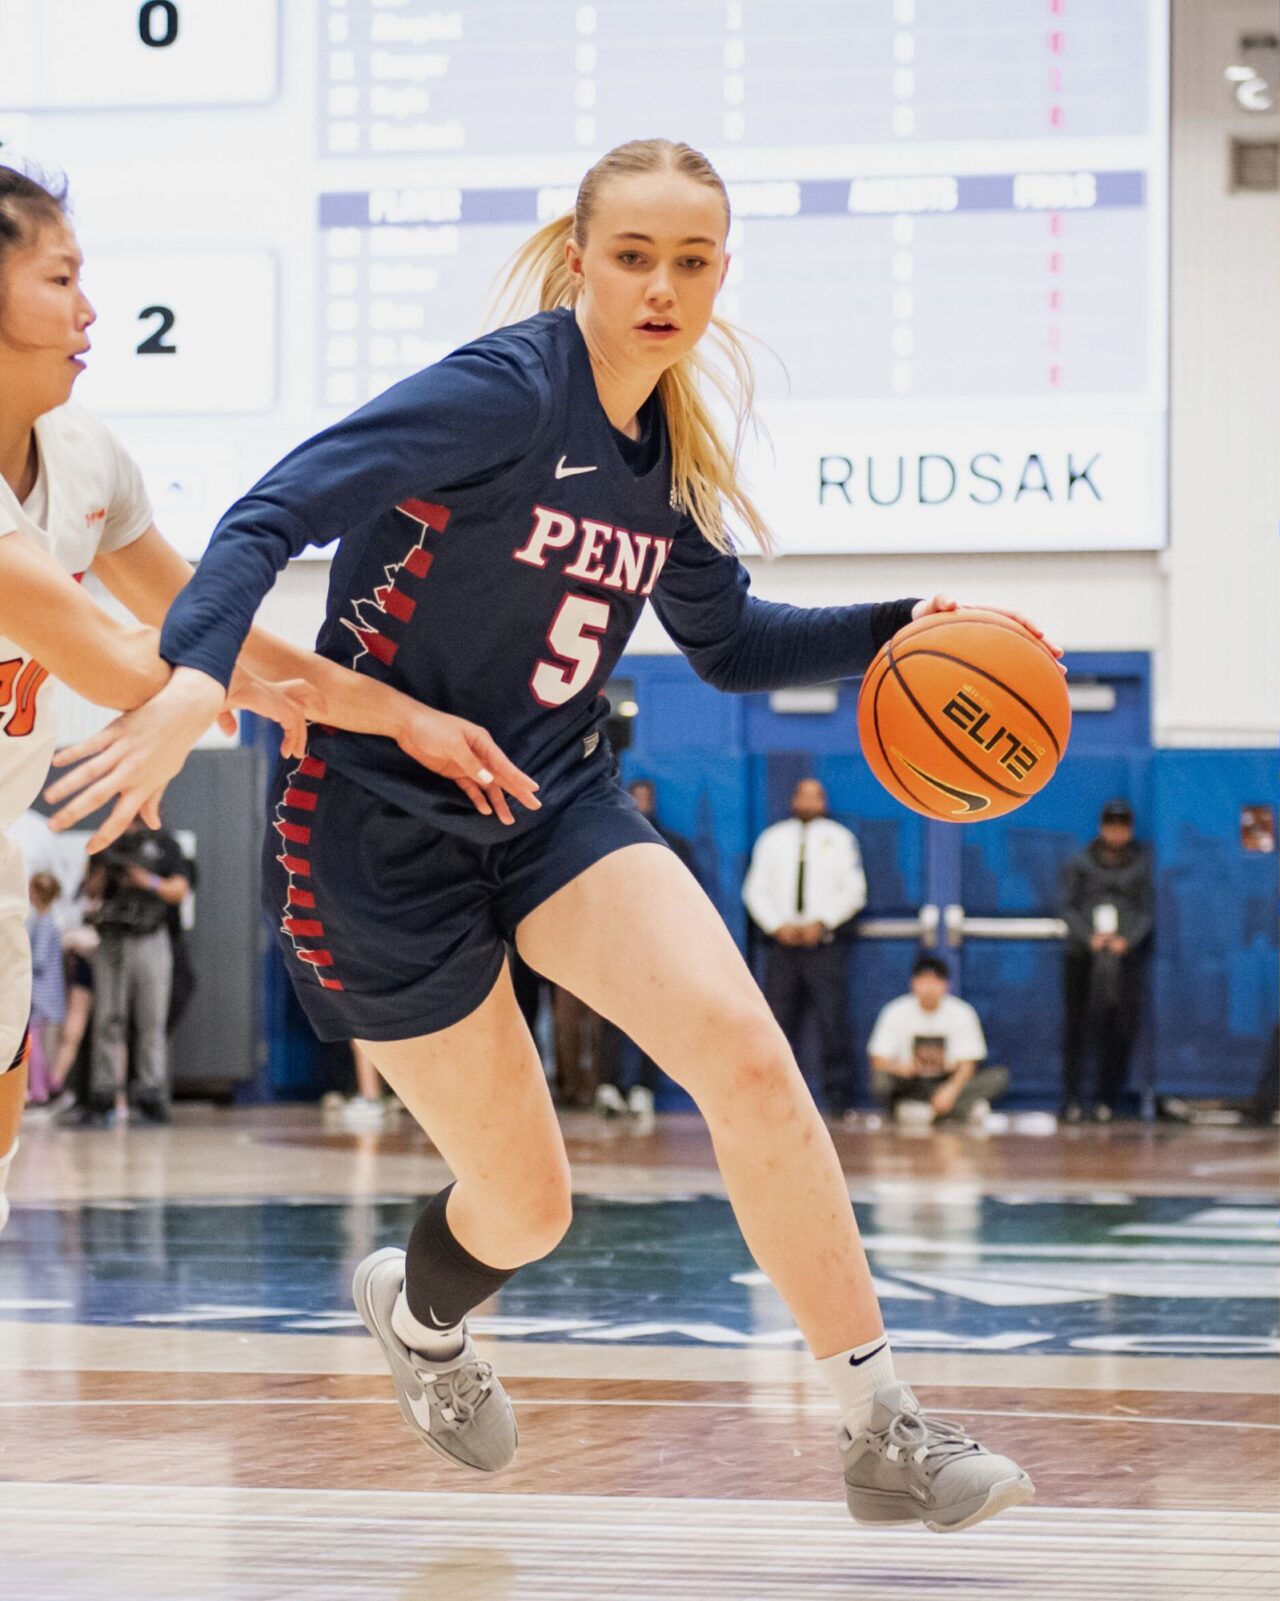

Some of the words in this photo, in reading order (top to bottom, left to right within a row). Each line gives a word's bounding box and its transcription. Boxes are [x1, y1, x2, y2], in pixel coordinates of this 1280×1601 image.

[138, 0, 179, 48] 0
[136, 305, 177, 354] 2
[819, 452, 1103, 506] RUDSAK
[529, 591, 611, 709] 5
[940, 688, 1040, 783] ELITE
